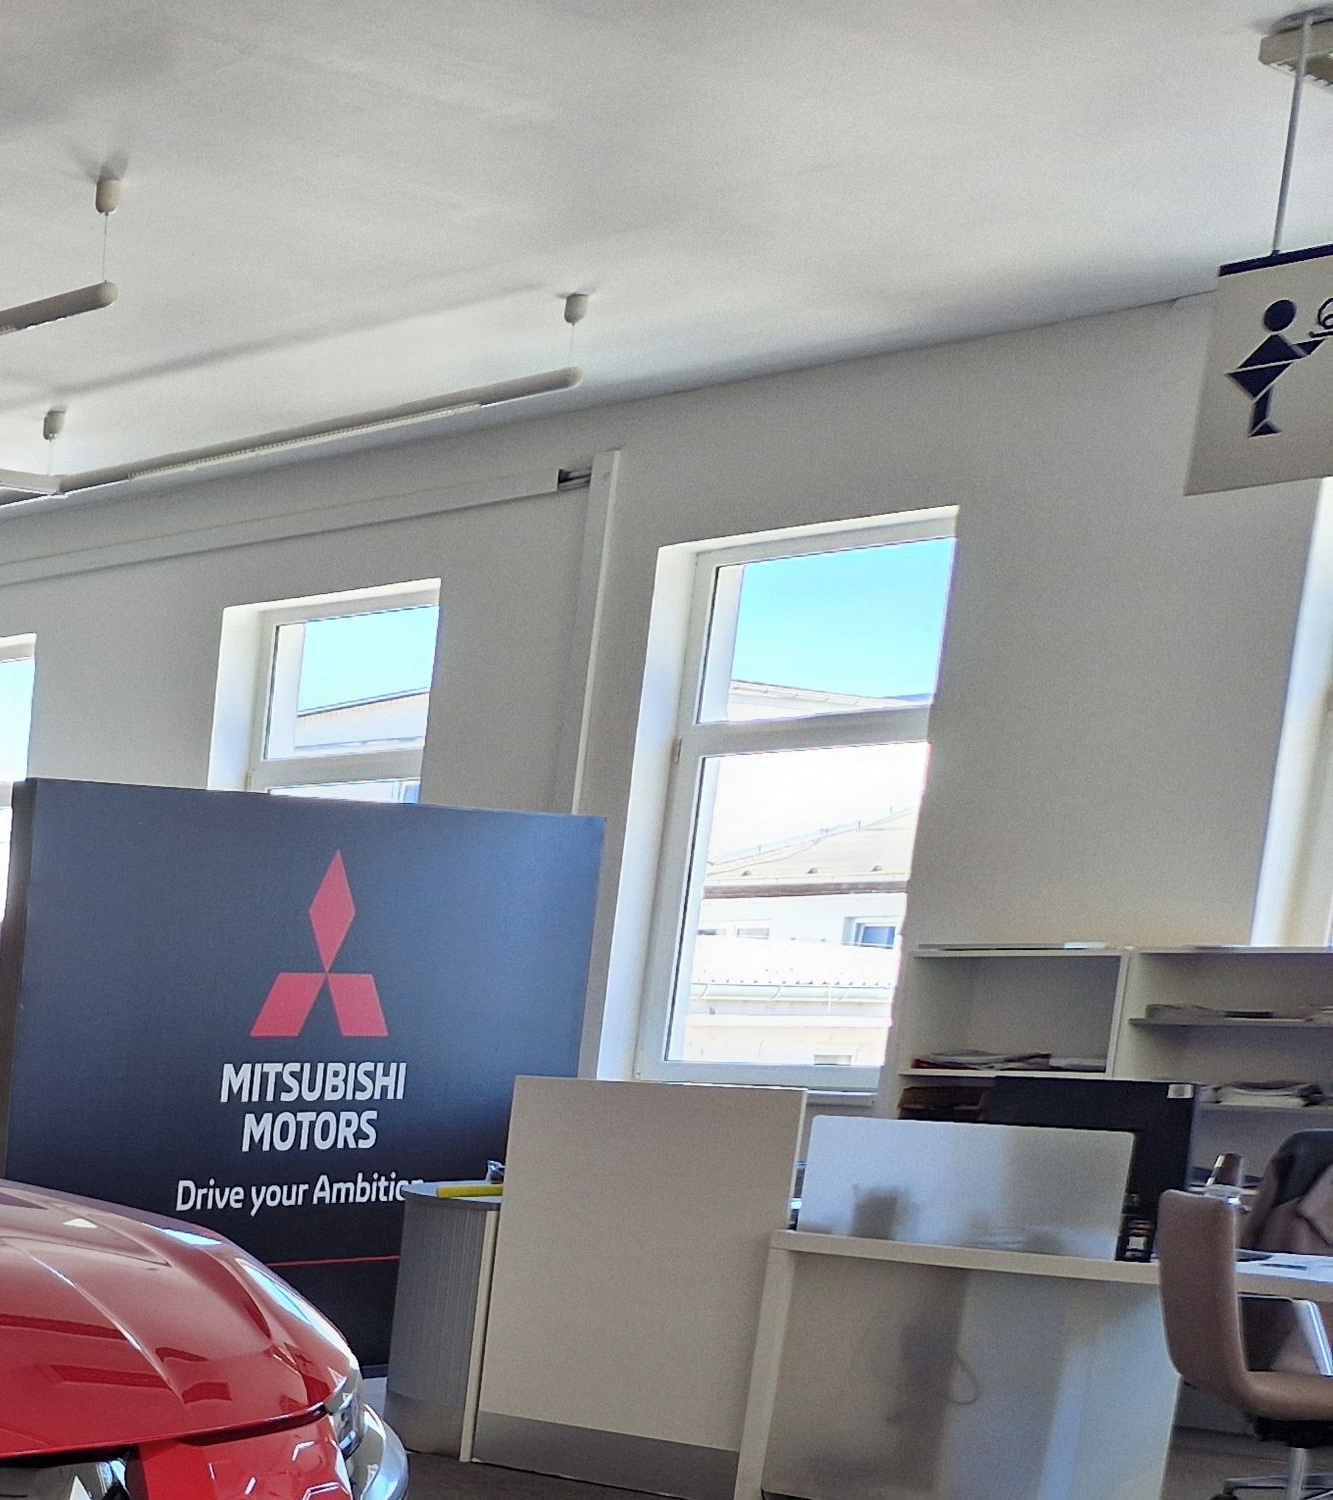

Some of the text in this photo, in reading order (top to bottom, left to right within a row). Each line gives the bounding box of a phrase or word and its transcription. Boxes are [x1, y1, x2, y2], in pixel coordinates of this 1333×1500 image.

[220, 1062, 407, 1103] MITSUBISHI
[241, 1111, 378, 1153] MOTORS
[176, 1171, 424, 1217] Drive your Ambitio
